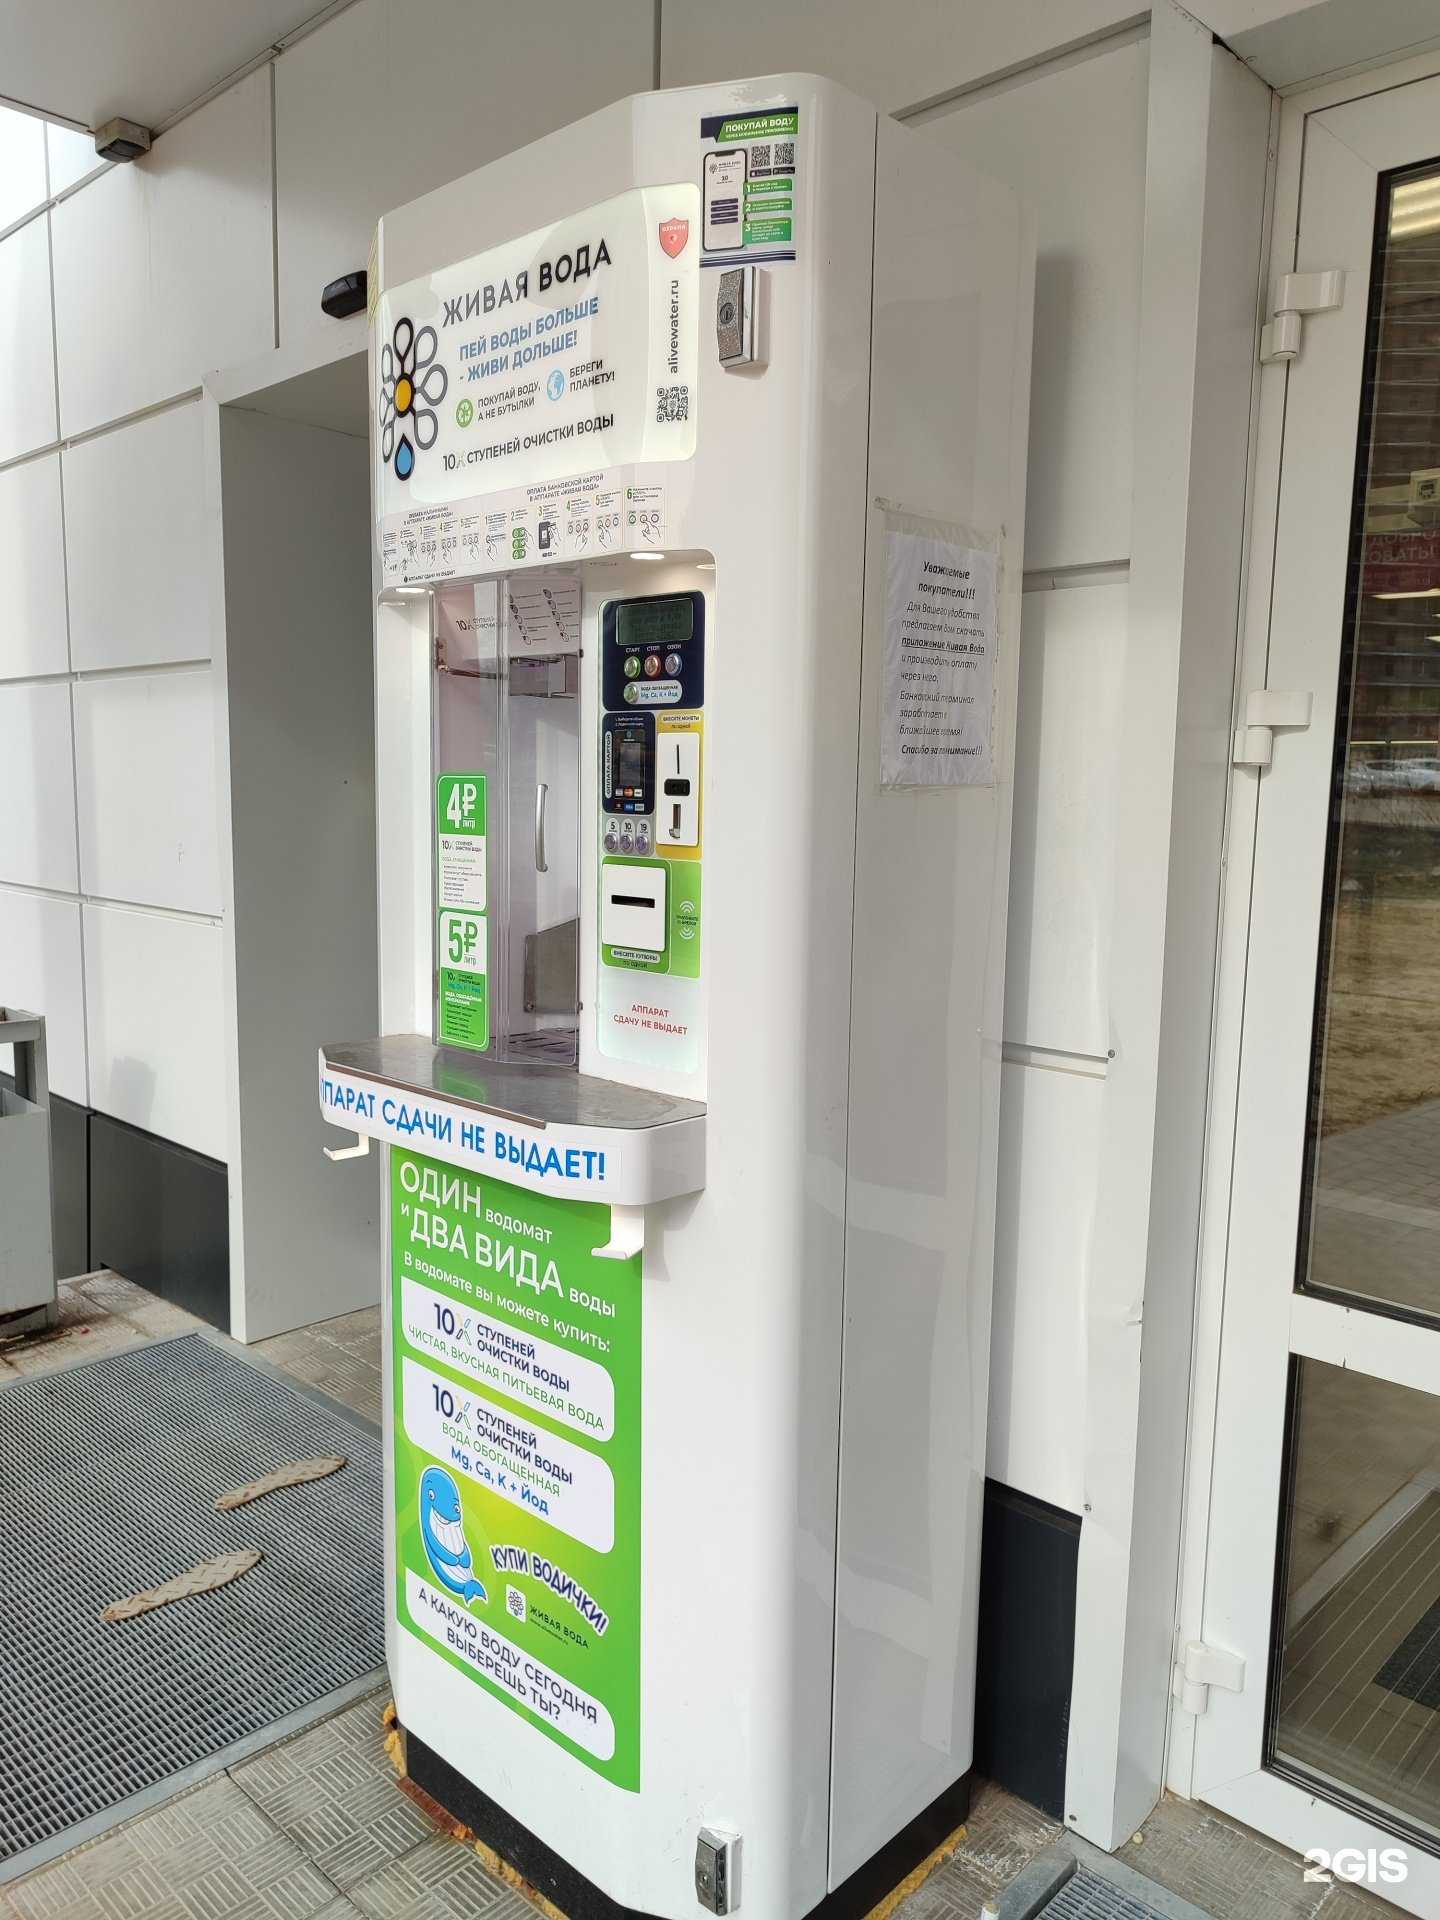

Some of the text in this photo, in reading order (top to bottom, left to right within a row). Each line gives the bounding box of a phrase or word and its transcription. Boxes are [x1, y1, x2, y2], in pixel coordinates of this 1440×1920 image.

[726, 117, 794, 132] ПОКУПАЙ ВОДУ
[745, 204, 751, 212] 2
[745, 223, 751, 232] 3
[442, 238, 612, 327] ЖИВАЯ ВОДА
[460, 296, 599, 361] ПЕЙ ВОДЫ БОЛЬШЕ
[668, 280, 679, 374] alivewater.ru
[468, 354, 508, 383] ЖИВИ
[512, 330, 578, 371] ДОЛЬШЕ!
[570, 359, 604, 378] БЕРЕГИ
[570, 370, 615, 392] ПЛАНЕТУ!
[478, 381, 541, 409] ПОКУПАЙ ВОДУ,
[478, 396, 535, 422] А НЕ БУТЫЛКИ
[443, 413, 614, 470] 10 СТУПЕНЕЙ ОЧИСТКИ ВОДЫ
[583, 473, 604, 484] КАРТОЙ
[627, 488, 632, 500] 6
[923, 561, 970, 580] Уважаемые
[918, 582, 976, 600] покупатели!!!
[906, 601, 921, 612] Для
[922, 602, 948, 616] Вашего
[456, 620, 467, 631] 10
[902, 618, 943, 633] предлагаем
[956, 628, 985, 638] скачать
[901, 637, 985, 654] приложение Живая Вода
[900, 672, 920, 682] через
[951, 660, 978, 670] оплату
[900, 690, 940, 702] Банковский
[900, 724, 939, 736] ближайшее
[902, 744, 930, 754] Спасибо
[610, 822, 616, 830] 5
[624, 822, 632, 830] 10
[442, 840, 449, 850] 10
[614, 1014, 688, 1035] СДАЧУ НЕ ВЫДАЕТ
[632, 1004, 669, 1018] АППАРАТ
[382, 1099, 452, 1144] СДАЧИ
[461, 1124, 485, 1154] НЕ
[495, 1131, 607, 1180] ВЫДАЕТ!
[400, 1161, 553, 1244] ОДИН водомат
[401, 1203, 616, 1318] и ДВА ВИДА воды
[404, 1251, 610, 1353] В водомате вы можете купить:
[434, 1303, 455, 1336] 10
[476, 1323, 536, 1360] СТУПЕНЕЙ
[408, 1324, 604, 1430] ЧИСТАЯ, ВКУСНАЯ ПИТЬЕВАЯ ВОДА
[477, 1340, 570, 1393] ОЧИСТКИ ВОДЫ
[432, 1384, 454, 1418] 10
[476, 1408, 538, 1450] СТУПЕНЕЙ
[442, 1422, 561, 1496] ВОДА ОБОГАЩЕННАЯ
[477, 1424, 572, 1485] ОЧИСТКИ ВОДЫ
[451, 1446, 473, 1472] Mg,
[475, 1460, 494, 1485] Ca,
[498, 1473, 506, 1490] K
[521, 1484, 550, 1516] Йод
[491, 1547, 528, 1573] КУПИ
[532, 1556, 607, 1633] ВОДИЧКИ!
[530, 1604, 562, 1632] ЖИВАЯ
[563, 1626, 589, 1648] ВОДА
[418, 1588, 429, 1602] А
[430, 1594, 478, 1638] КАКУЮ
[481, 1622, 522, 1668] ВОДУ
[524, 1662, 599, 1724] СЕГОДНЯ
[446, 1626, 527, 1697] ВЫБЕРЕШЬ
[530, 1686, 561, 1722] ТЫ?
